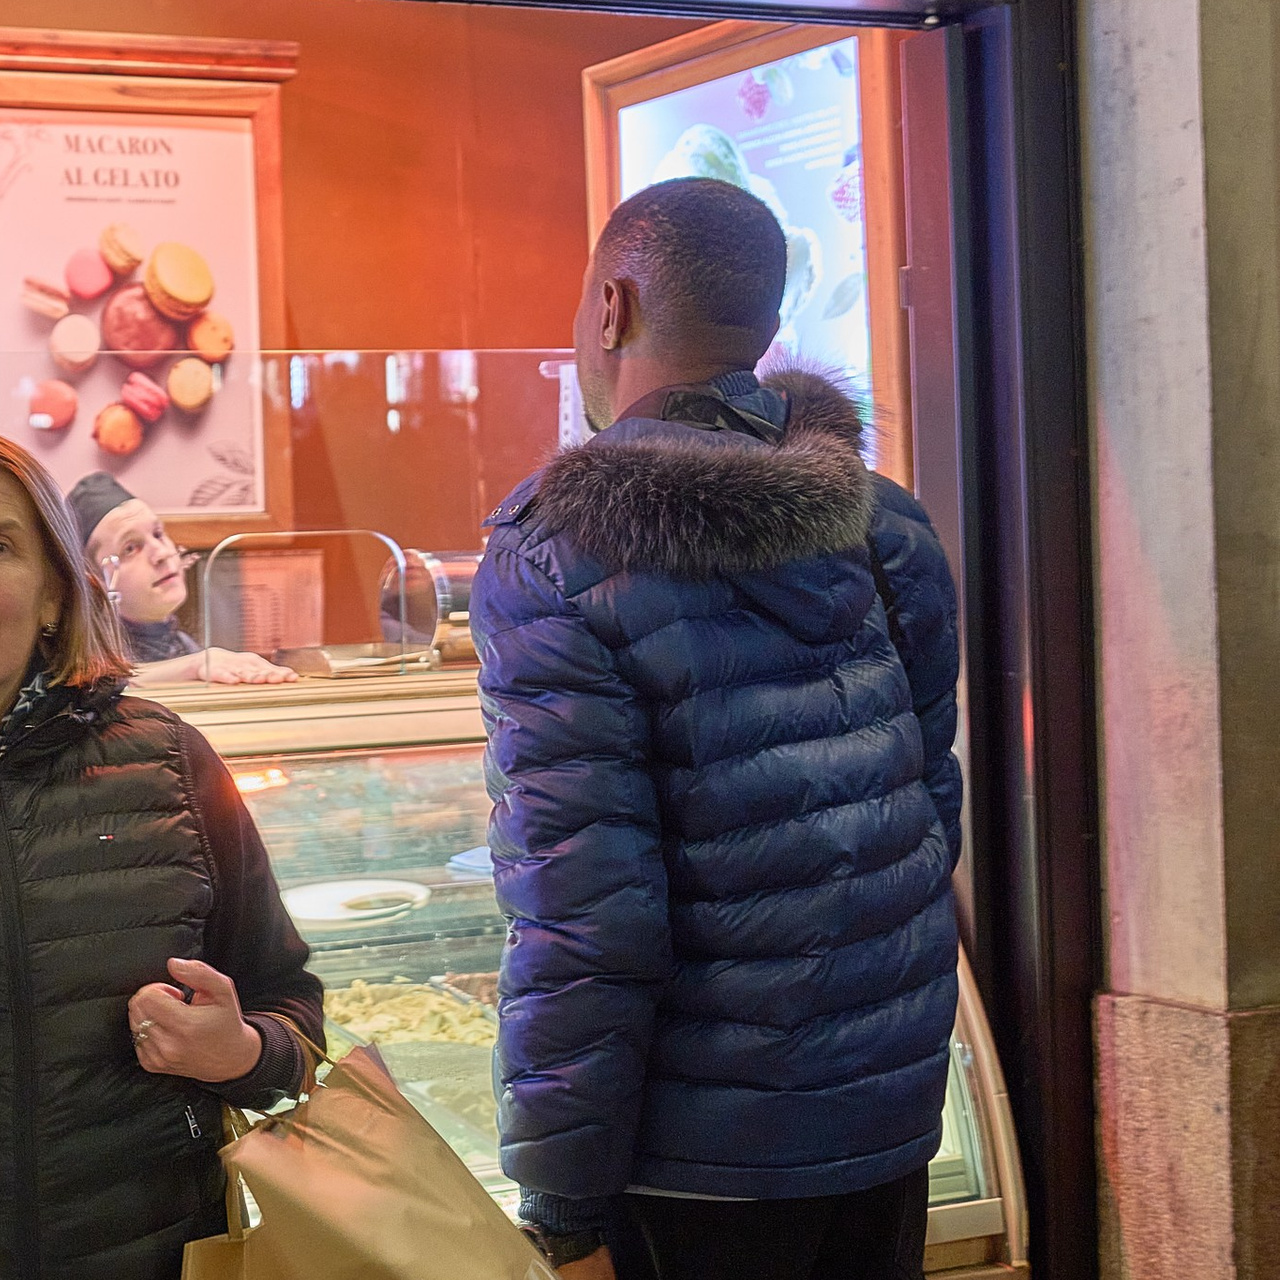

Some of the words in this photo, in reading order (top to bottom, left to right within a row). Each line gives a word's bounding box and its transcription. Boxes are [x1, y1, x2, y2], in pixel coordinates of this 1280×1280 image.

[64, 134, 174, 155] MACARON
[64, 167, 87, 186] AL
[93, 167, 180, 188] GELATO
